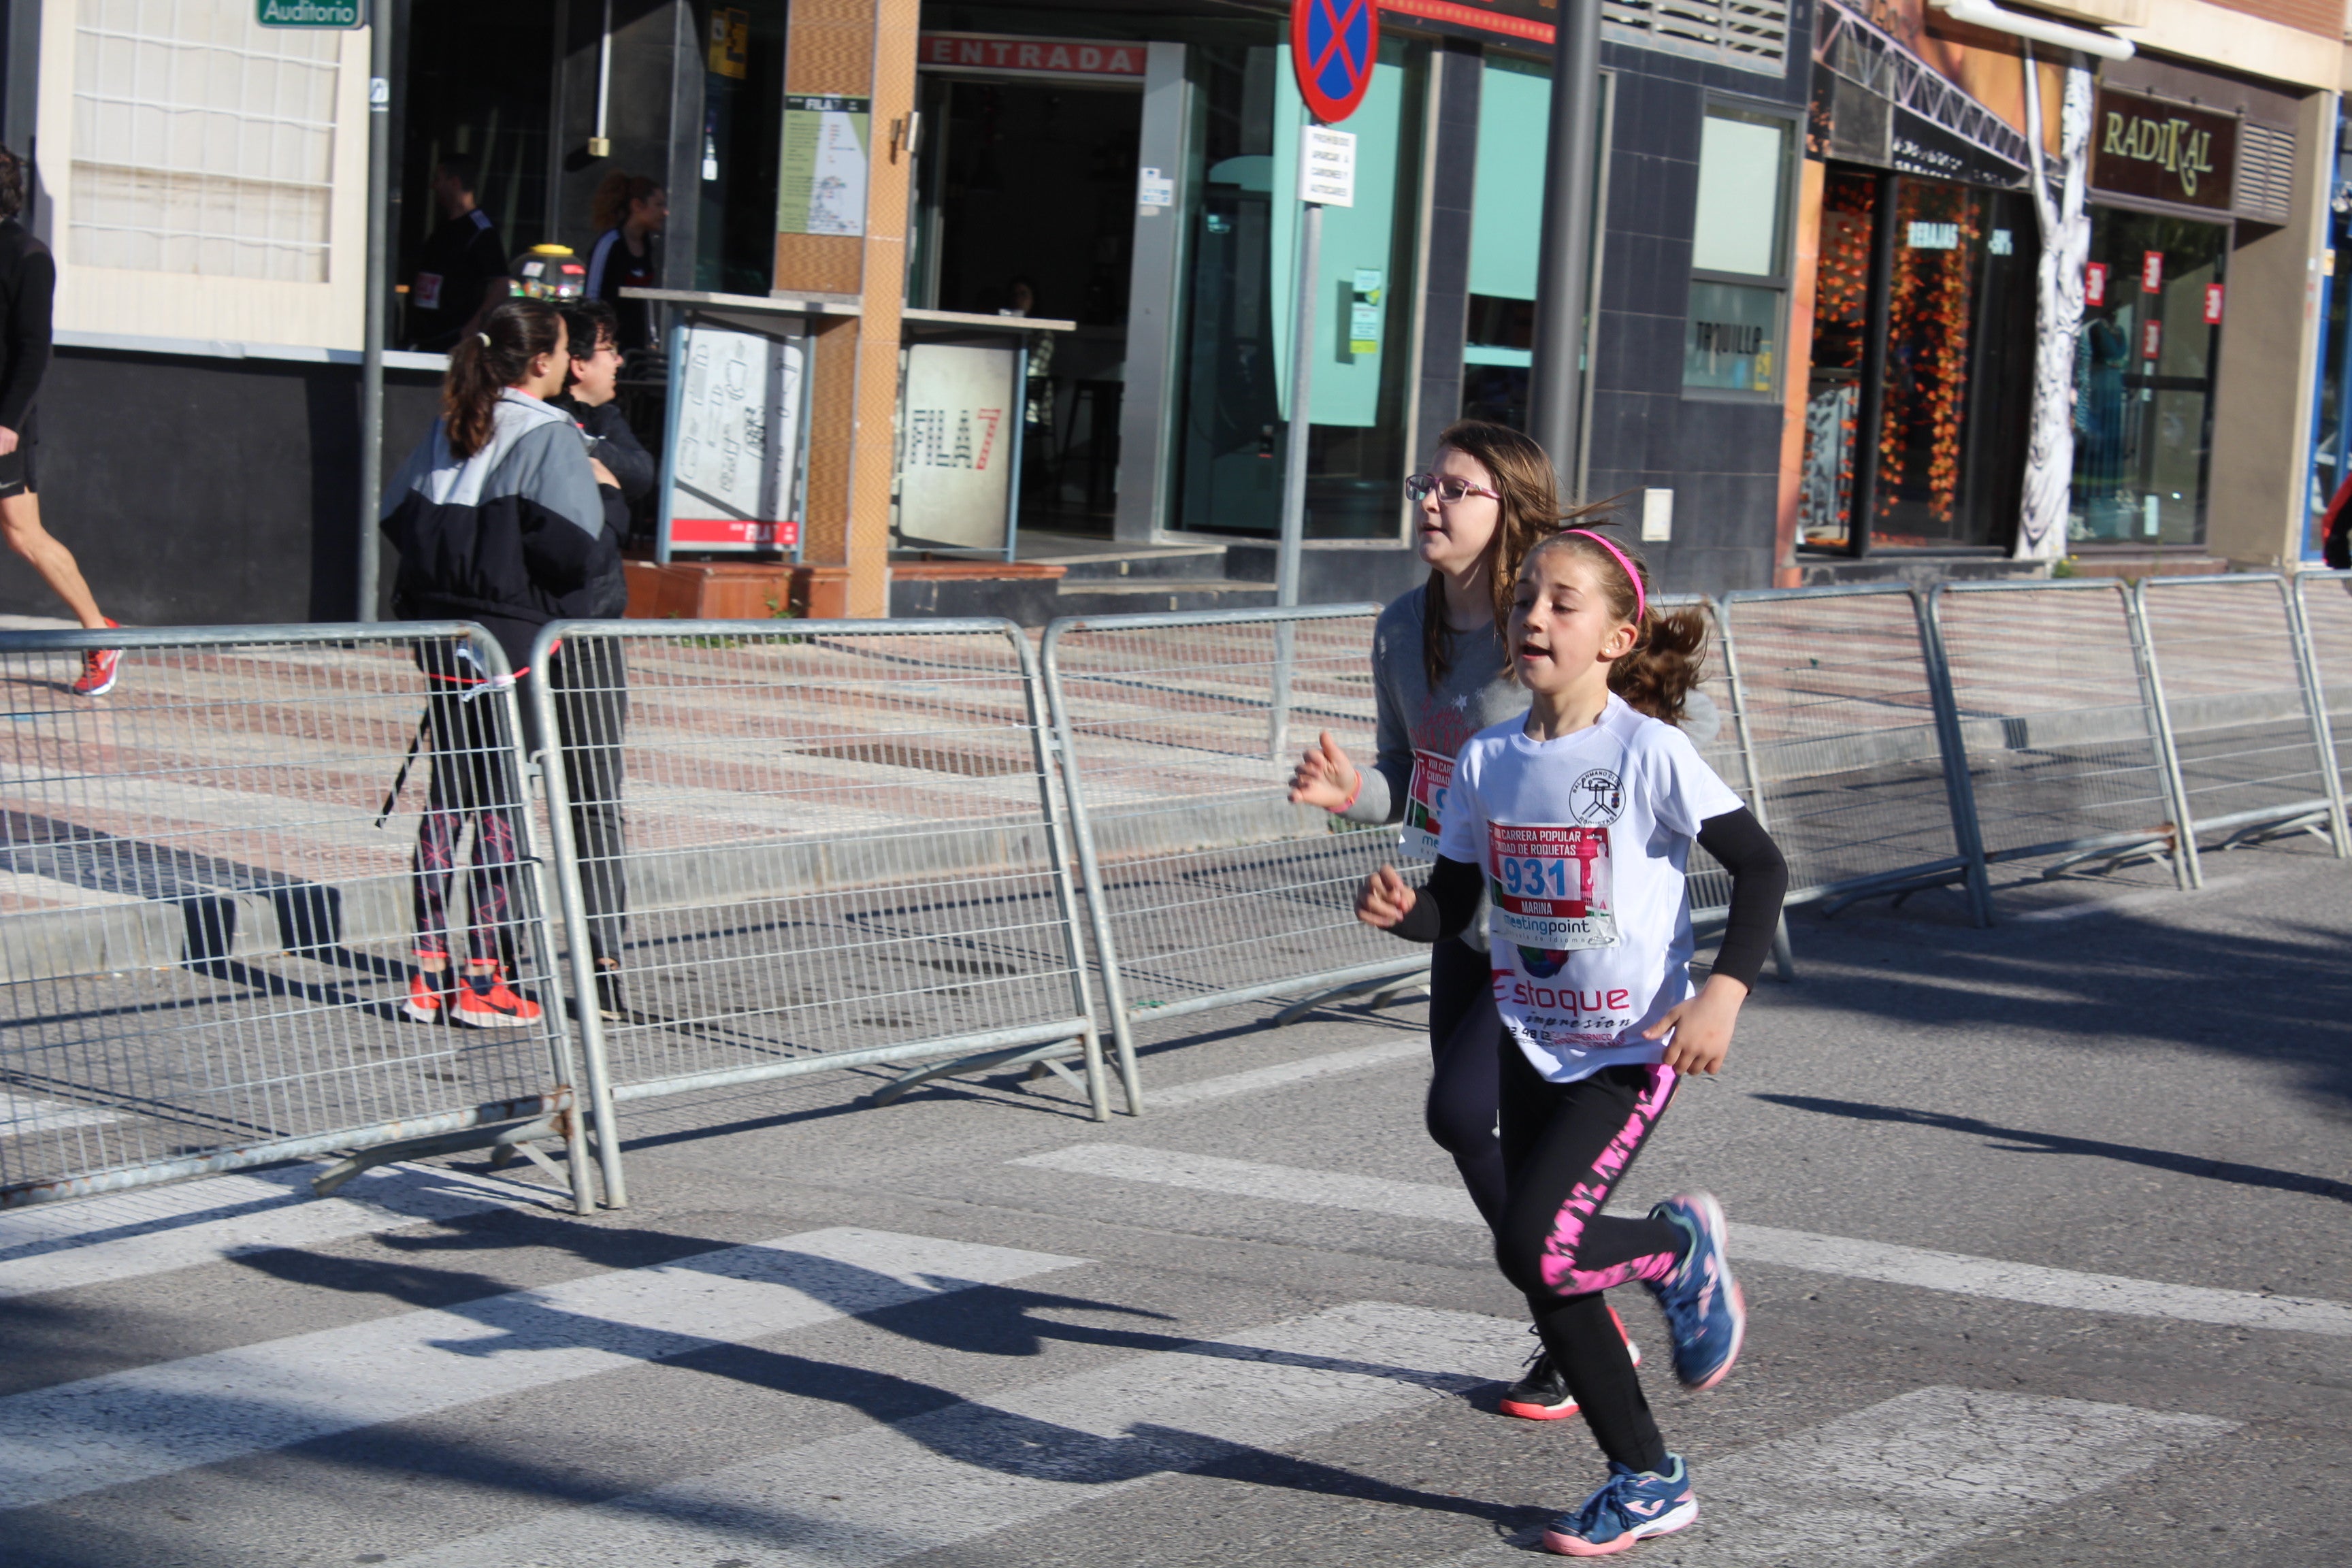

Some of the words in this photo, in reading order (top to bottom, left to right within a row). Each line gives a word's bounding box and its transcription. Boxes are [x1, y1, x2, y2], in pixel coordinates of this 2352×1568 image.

[263, 0, 355, 22] Auditorio
[932, 40, 1132, 71] ENTRADA
[2103, 112, 2214, 197] RADIKAL
[1501, 829, 1537, 841] CARRERA
[1540, 830, 1581, 843] POPULAR
[1518, 843, 1529, 855] DE
[1531, 844, 1576, 856] ROQUETAS
[1504, 857, 1565, 896] 931
[1521, 900, 1553, 915] MARINA
[1503, 913, 1590, 935] meetingpoint
